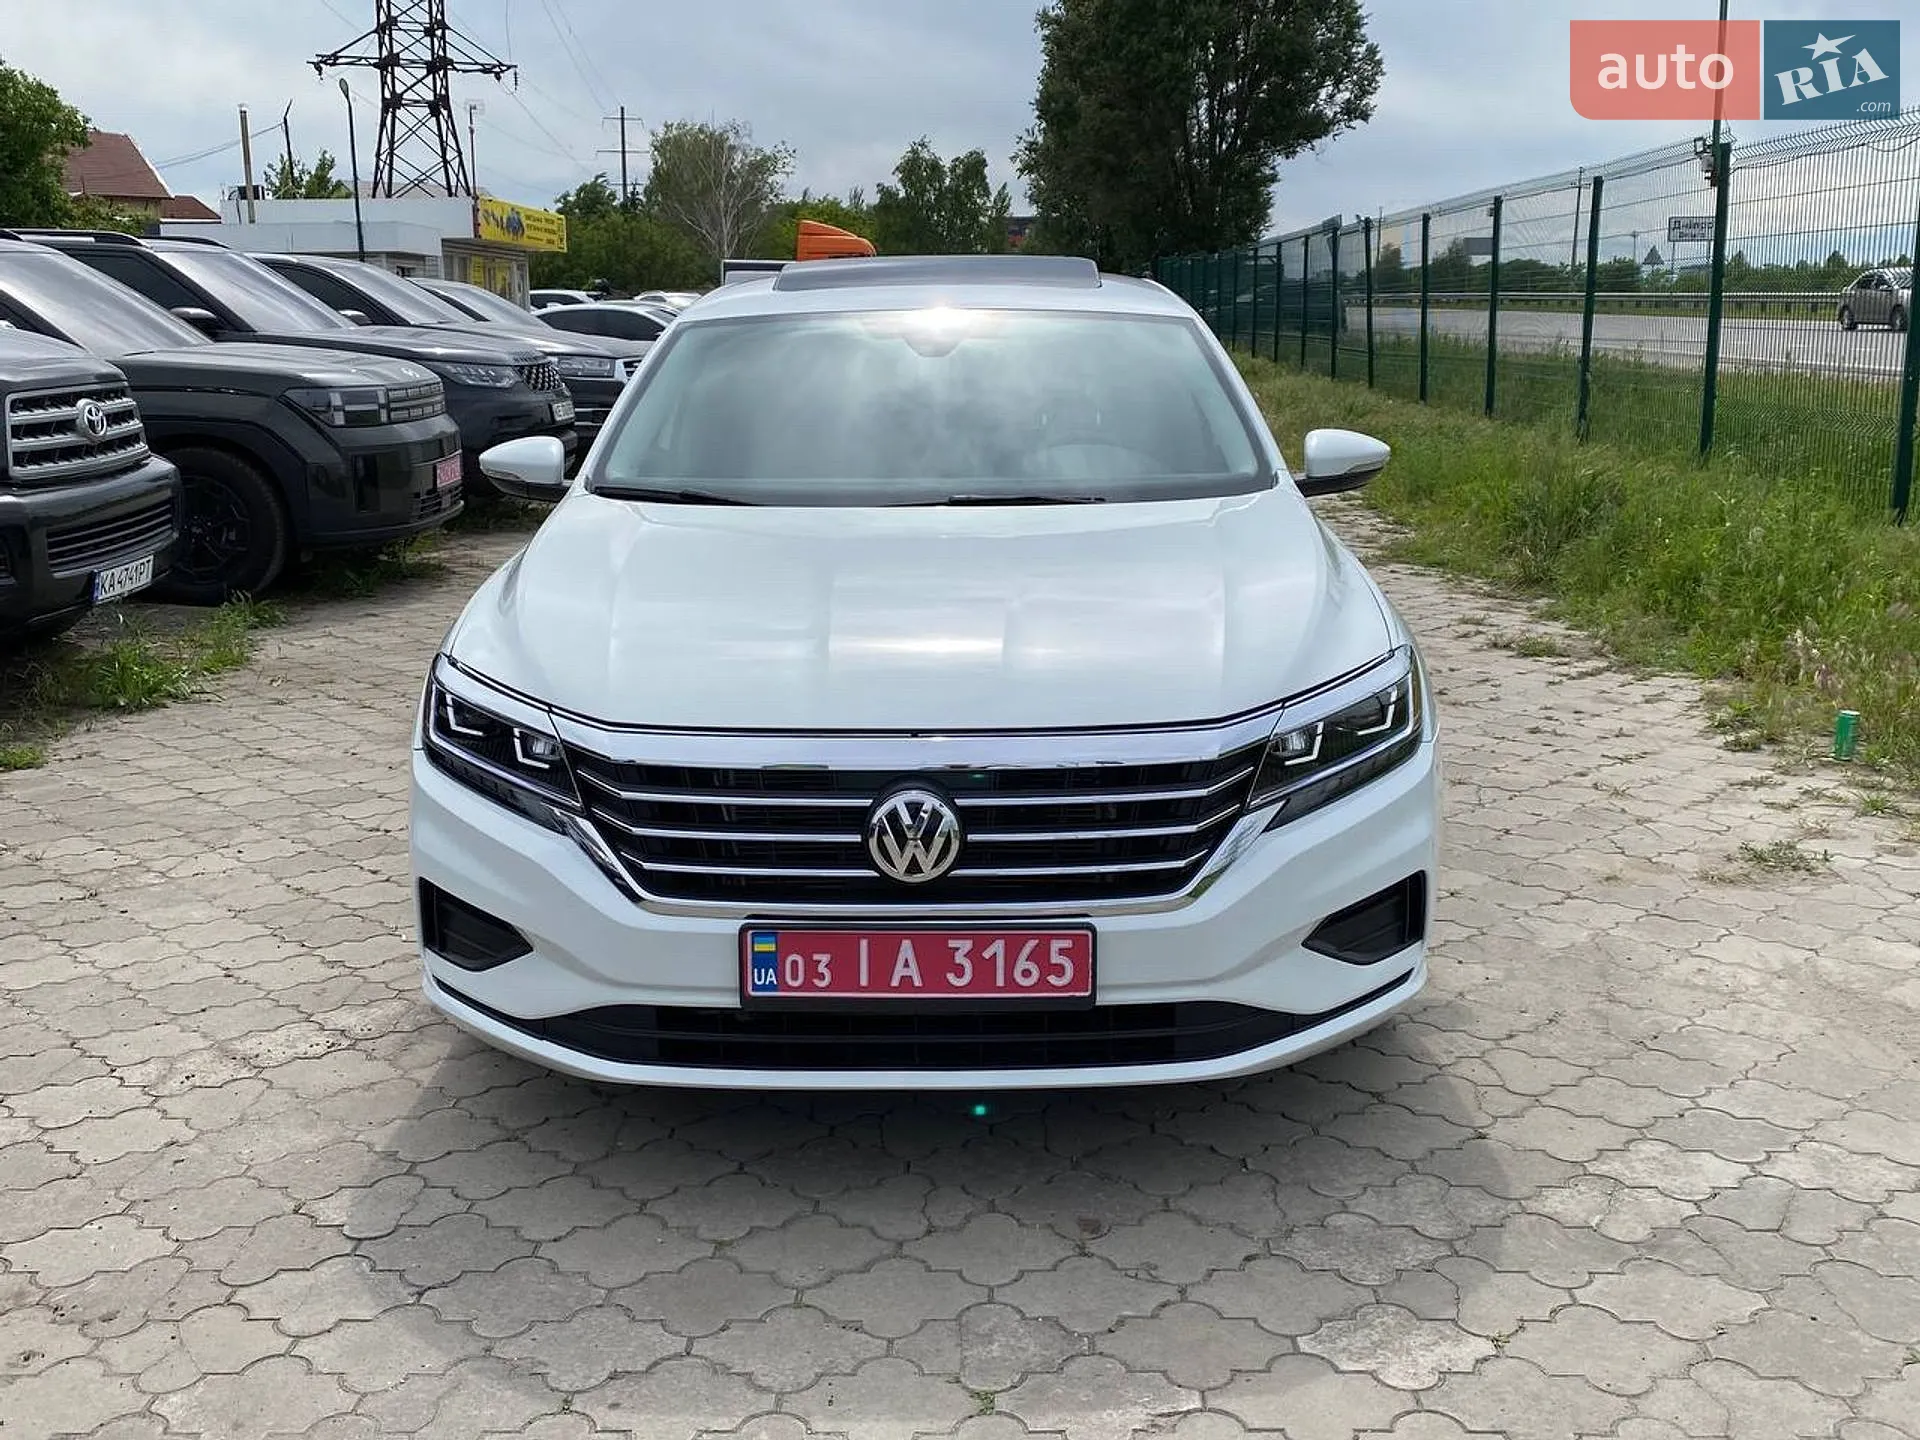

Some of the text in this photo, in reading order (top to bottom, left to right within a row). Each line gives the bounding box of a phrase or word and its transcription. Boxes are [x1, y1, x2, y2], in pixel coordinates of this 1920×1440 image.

[99, 571, 115, 596] KA
[784, 953, 833, 988] 03
[946, 938, 1074, 988] 3165
[754, 968, 777, 985] UA
